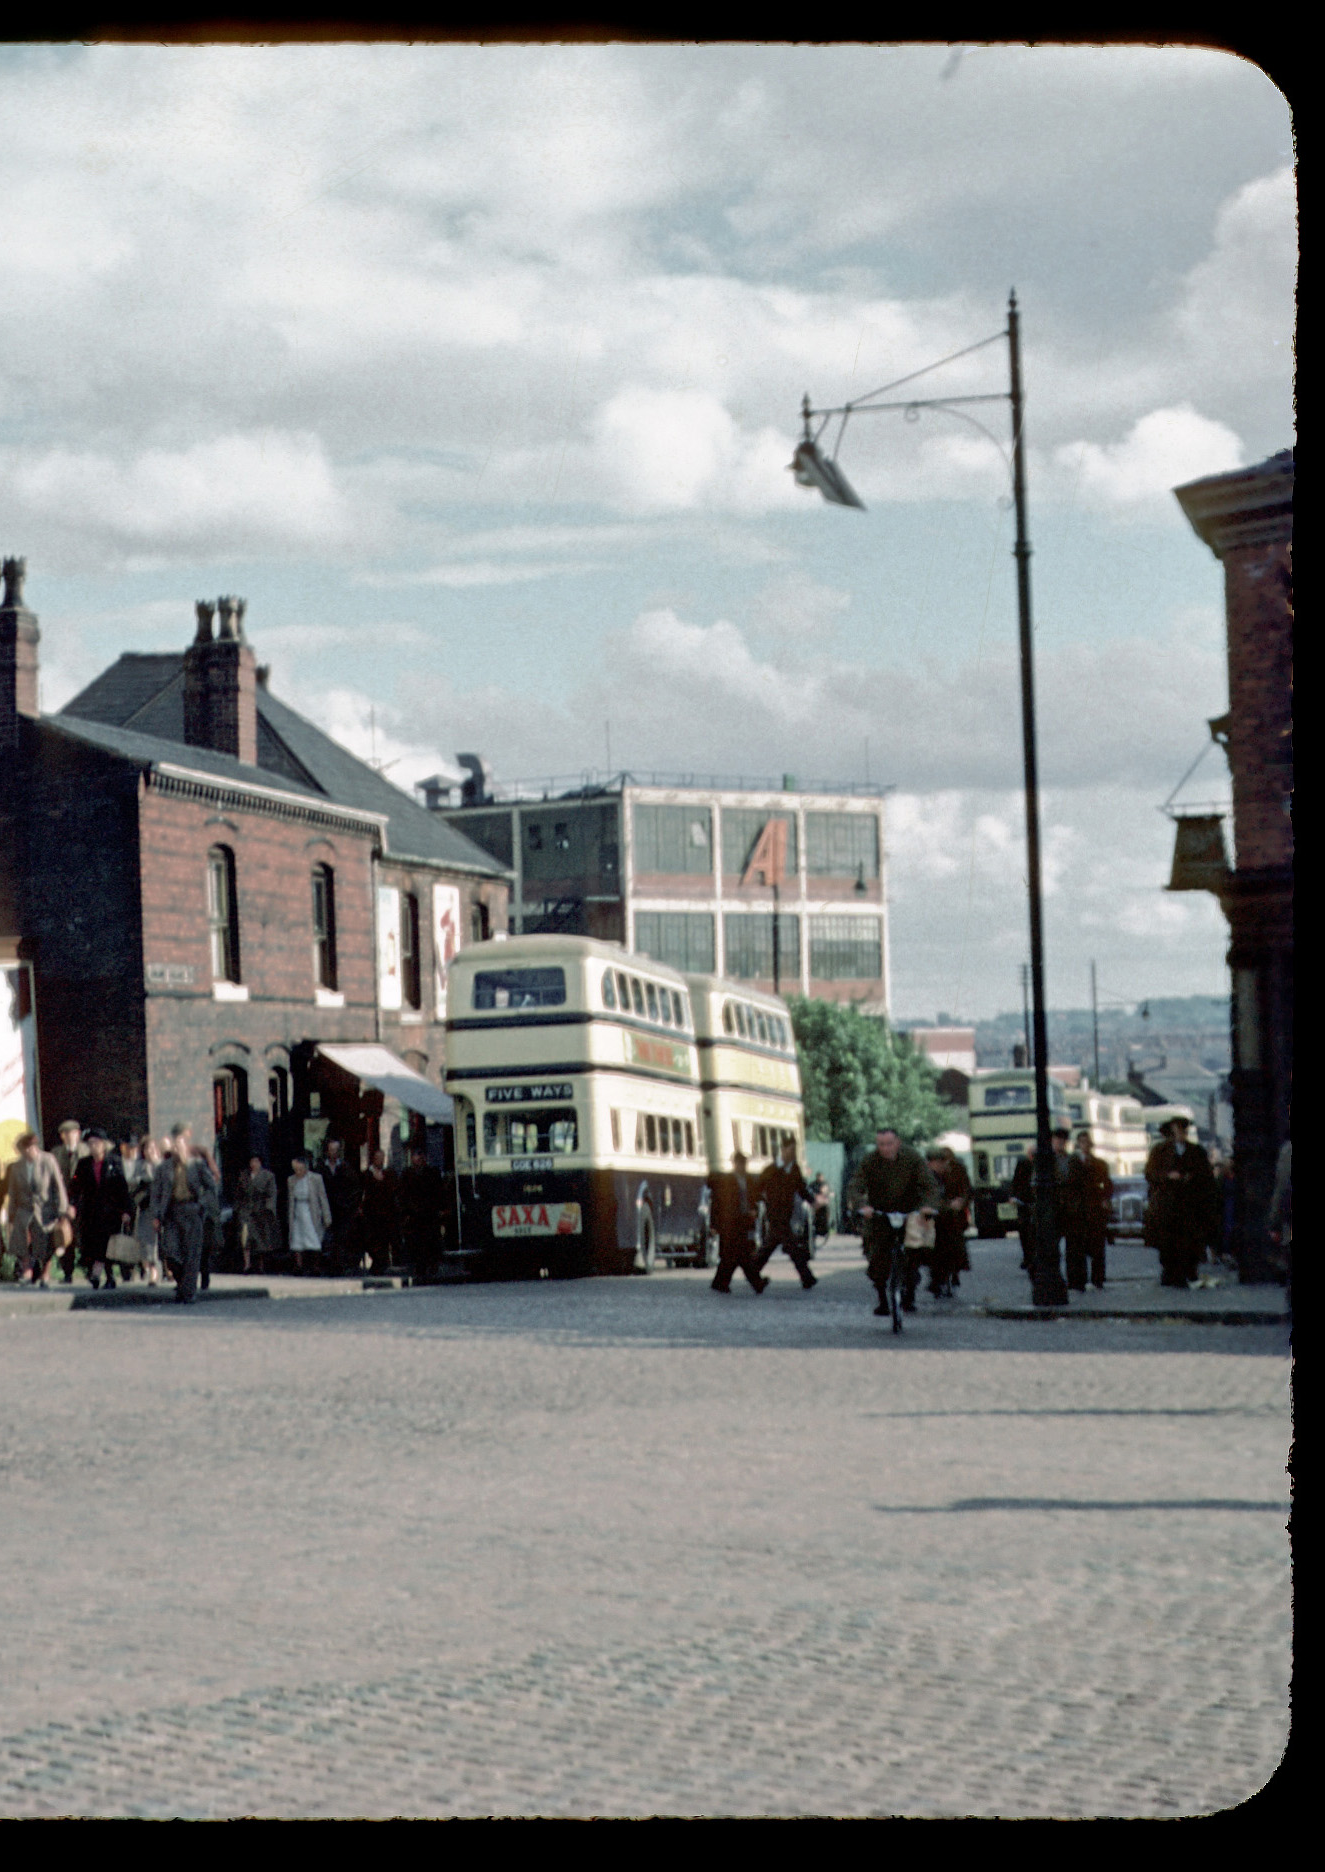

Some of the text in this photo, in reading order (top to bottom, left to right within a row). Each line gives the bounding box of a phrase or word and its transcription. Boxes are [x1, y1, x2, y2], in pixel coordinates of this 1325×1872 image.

[740, 818, 788, 886] A
[487, 1084, 572, 1101] FIVE WAYS
[496, 1204, 550, 1230] SAXA
